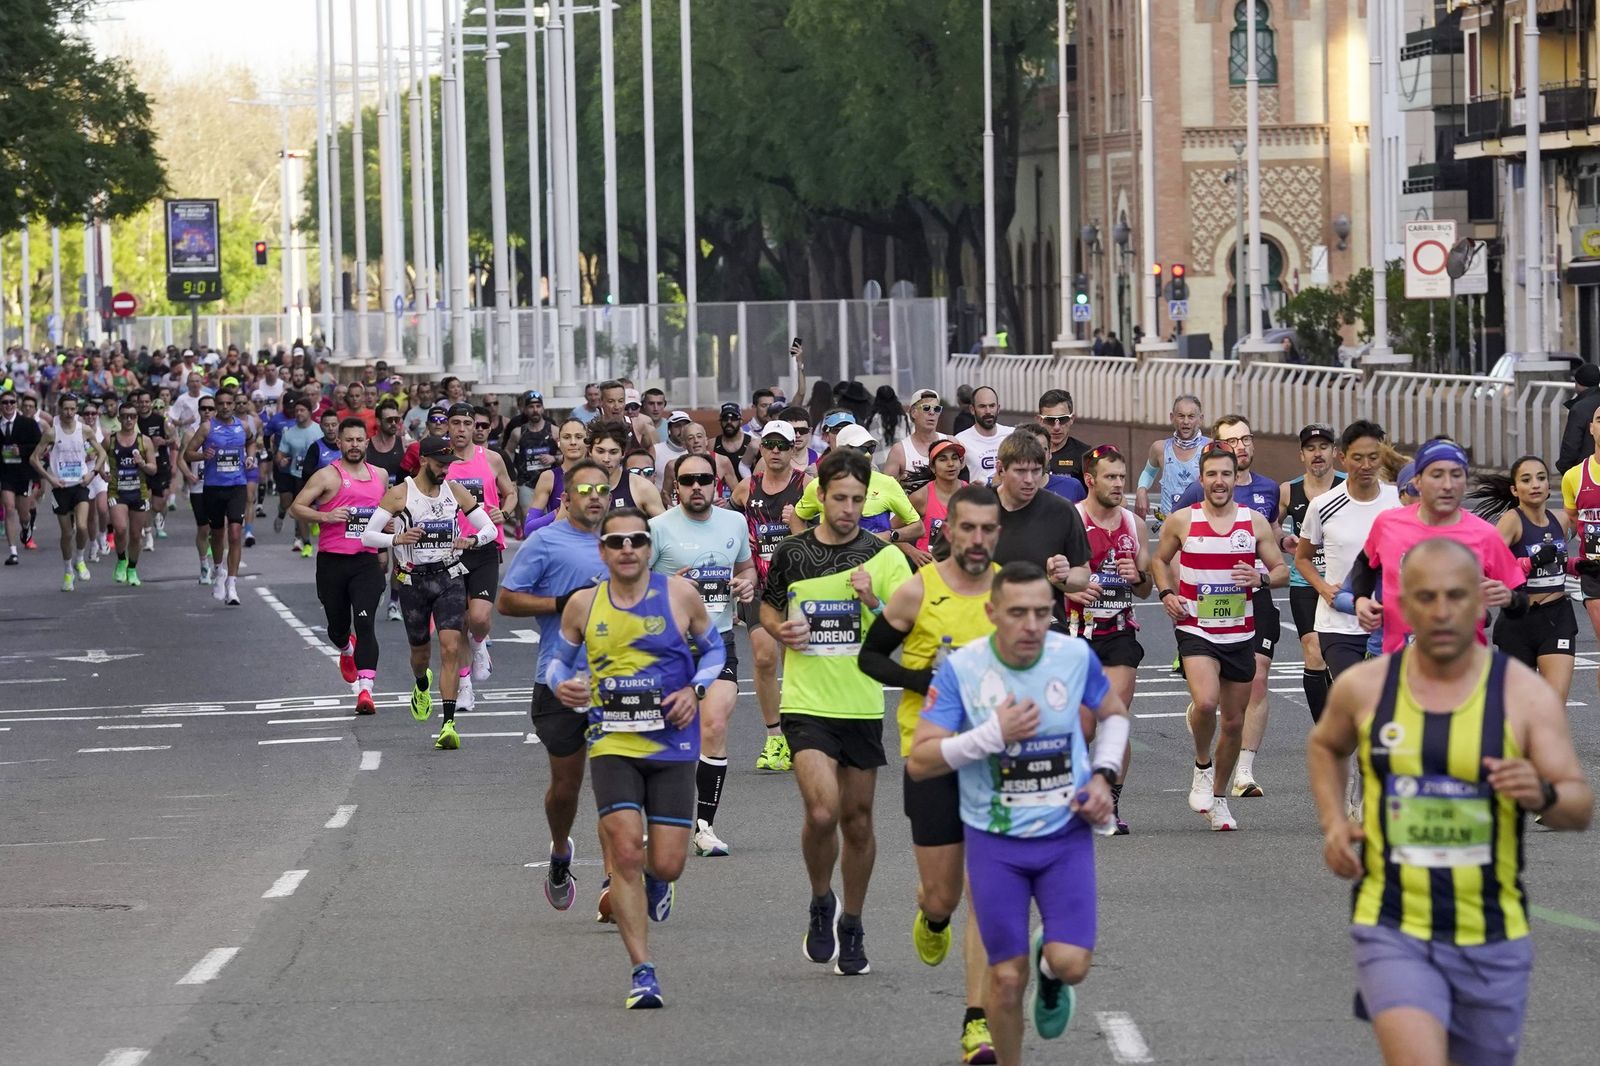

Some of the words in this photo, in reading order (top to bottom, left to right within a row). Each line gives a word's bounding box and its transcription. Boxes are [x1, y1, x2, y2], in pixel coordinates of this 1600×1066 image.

[183, 281, 216, 294] 9:01
[762, 544, 777, 553] IRO
[1214, 608, 1231, 616] FON
[820, 620, 840, 628] 4974
[810, 630, 855, 643] MORENO
[621, 696, 640, 704] 4035
[602, 711, 632, 720] MIGUEL
[634, 710, 664, 720] ANGEL
[1026, 738, 1068, 752] ZURICH
[1000, 778, 1038, 792] JESUS
